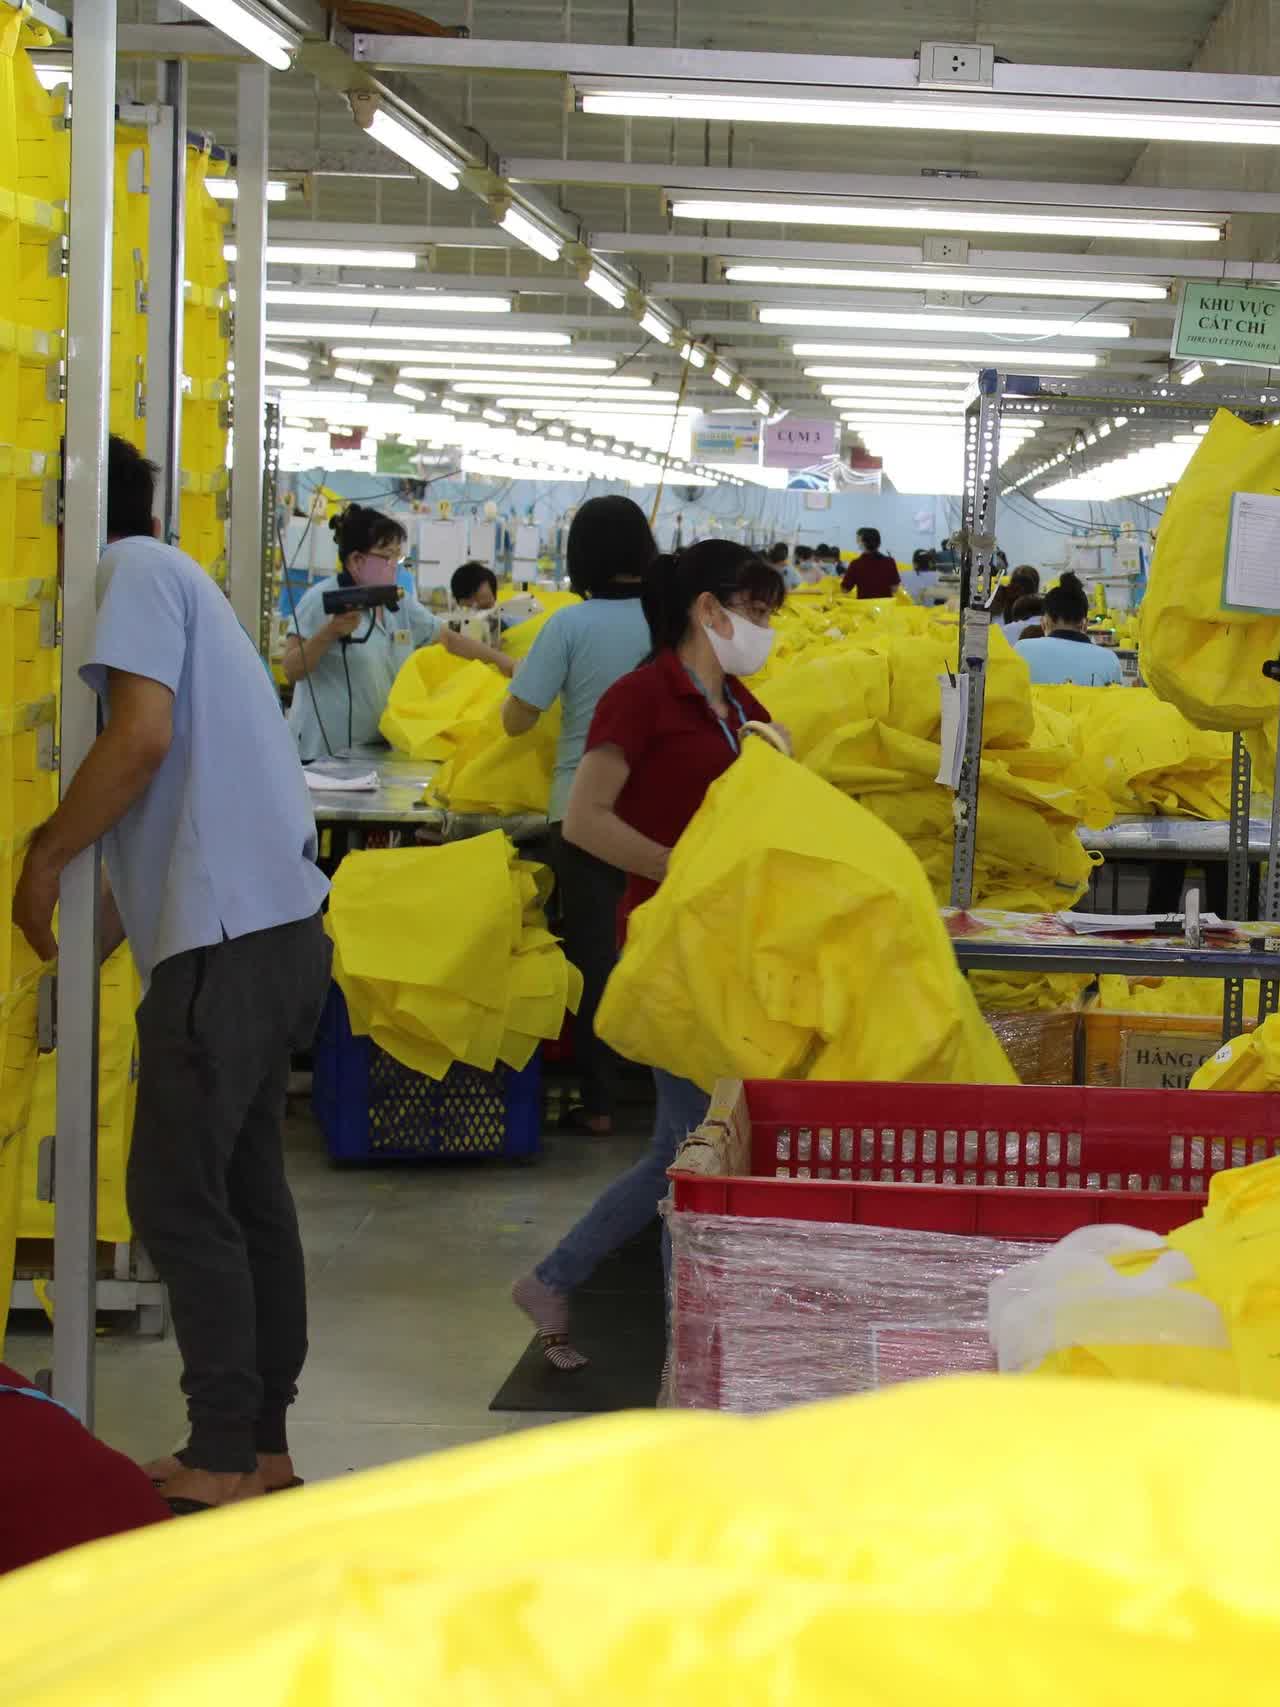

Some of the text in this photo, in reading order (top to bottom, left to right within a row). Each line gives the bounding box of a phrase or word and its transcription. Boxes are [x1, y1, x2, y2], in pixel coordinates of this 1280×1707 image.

[1199, 297, 1234, 312] KHU
[1187, 335, 1277, 351] THREAD CUTTING AREA
